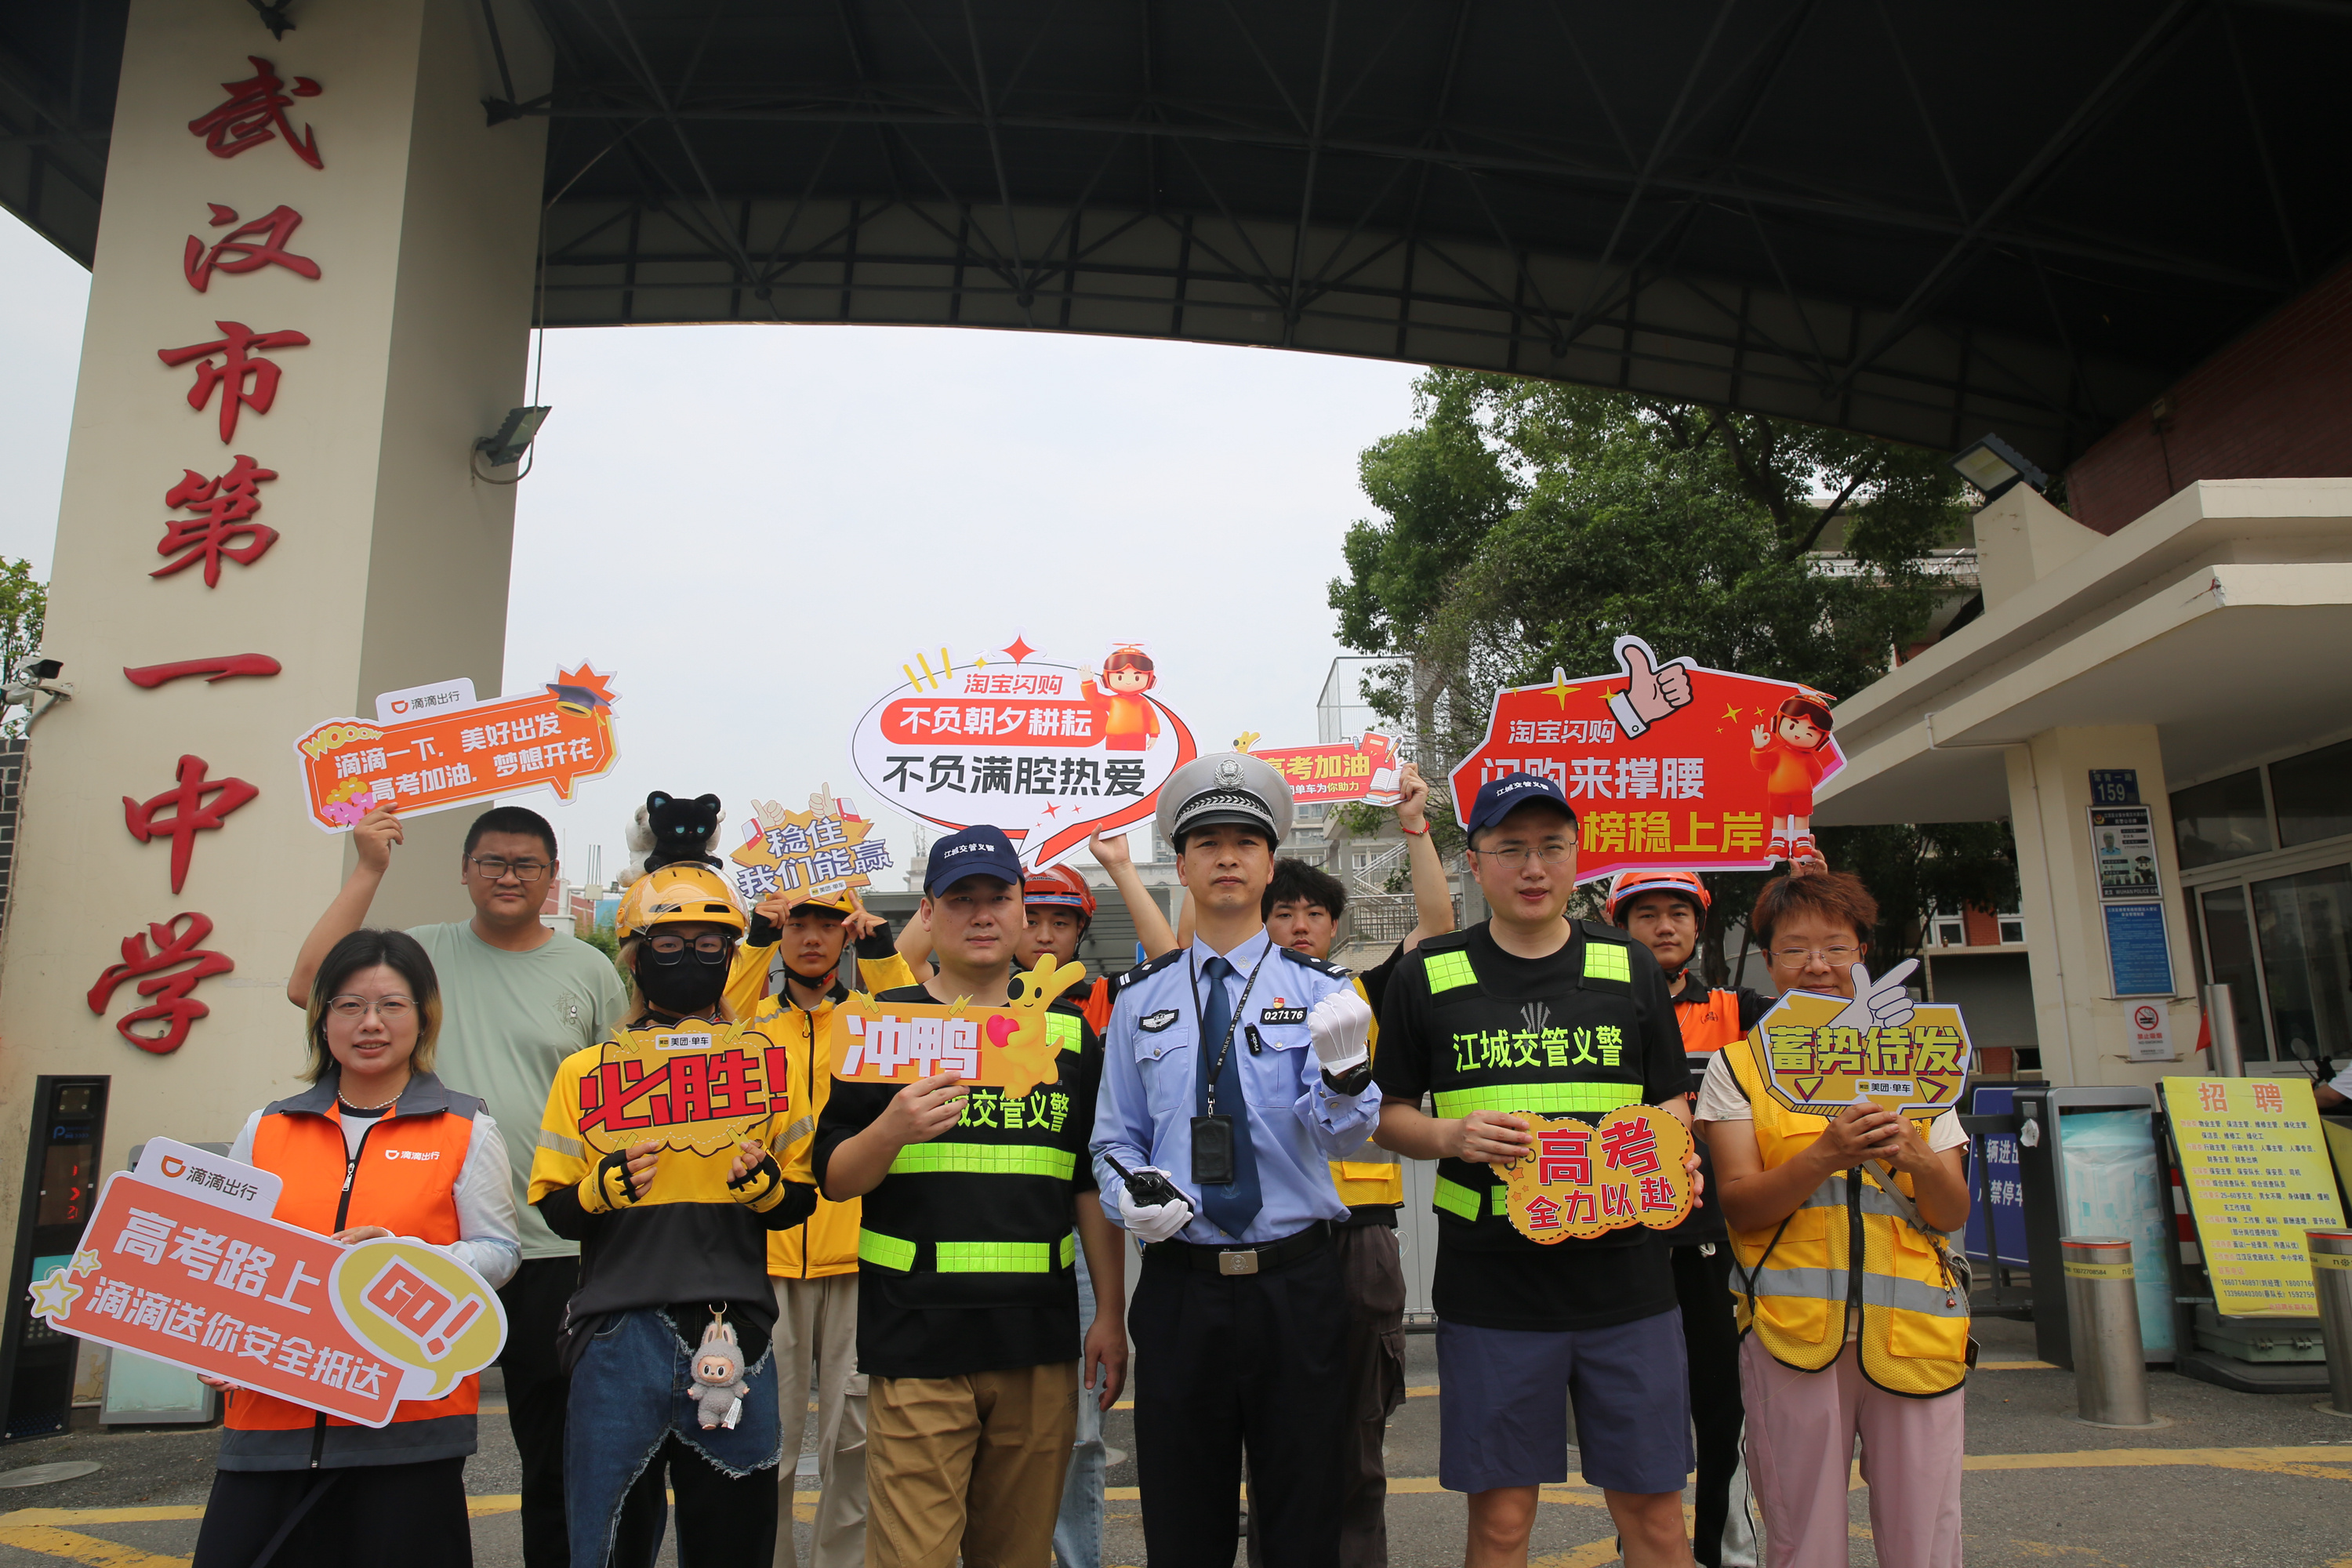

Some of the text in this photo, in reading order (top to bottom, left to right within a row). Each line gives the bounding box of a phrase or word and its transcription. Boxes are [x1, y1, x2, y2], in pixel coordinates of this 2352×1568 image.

[86, 55, 325, 1055] 武汉市第一中学
[411, 690, 461, 710] 滴滴出行
[964, 673, 1063, 695] 淘宝闪购
[899, 706, 1092, 737] 不负朝夕耕耘
[1508, 720, 1617, 745] 淘宝闪购
[882, 754, 1146, 797] 不负满腔热爱
[1263, 752, 1370, 781] 高考加油
[1496, 781, 1549, 797] 江城交管义警
[2098, 783, 2125, 801] 159
[764, 816, 848, 858] 稳住
[1578, 811, 1764, 854] 榜稳上岸
[944, 843, 995, 858] 江城交管义警
[737, 839, 894, 899] 我们能赢
[1221, 1035, 1232, 1054] POLICE
[1234, 1004, 1244, 1021] POLICE
[1264, 1011, 1304, 1021] 027176
[671, 1036, 710, 1047] 美团·单车
[840, 1014, 983, 1081] 冲鸭
[1452, 1025, 1623, 1073] 江城交管义警
[1769, 1025, 1964, 1076] 蓄势待发
[1871, 1083, 1911, 1093] 美团·单车
[2198, 1082, 2284, 1113] 招聘
[931, 1088, 1070, 1133] 交管义警
[400, 1150, 441, 1161] 滴滴出行
[1536, 1116, 1661, 1187] 高考
[1974, 1139, 2020, 1164] 辆进出
[186, 1166, 259, 1202] 滴滴出行
[1977, 1179, 2023, 1207] 禁停车
[1524, 1176, 1677, 1232] 全力以赴
[112, 1206, 321, 1316] 高考路上
[85, 1276, 389, 1401] 滴滴送你安全抵达
